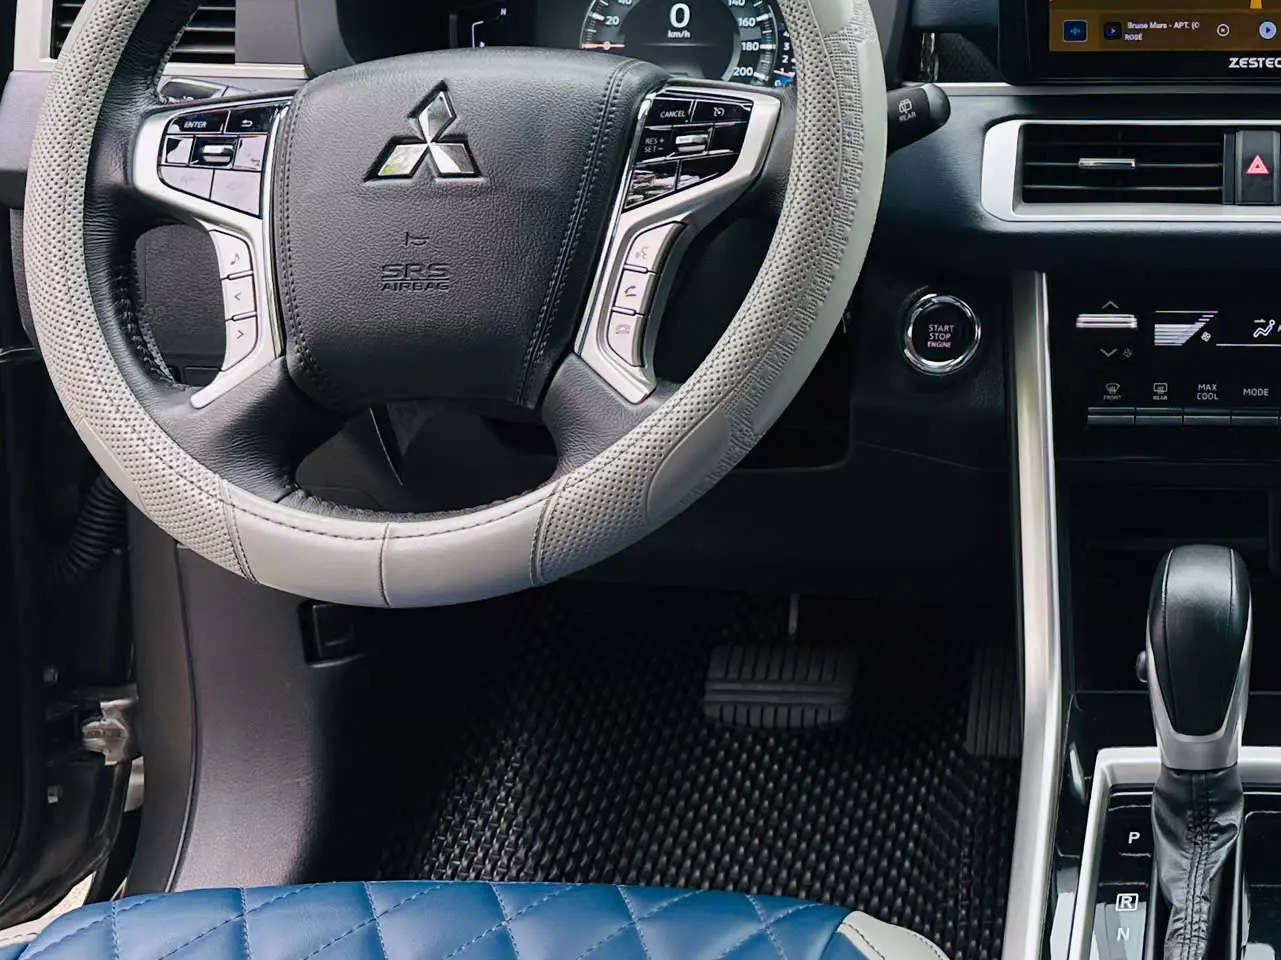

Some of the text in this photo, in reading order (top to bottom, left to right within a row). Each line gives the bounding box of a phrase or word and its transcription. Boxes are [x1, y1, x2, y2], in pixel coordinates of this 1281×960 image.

[605, 15, 620, 25] 20
[669, 3, 691, 28] 0
[738, 17, 756, 27] 160
[667, 30, 691, 39] km/h
[741, 41, 759, 51] 180
[733, 67, 754, 77] 200
[660, 110, 686, 119] CANCEL
[183, 120, 207, 129] ENTER
[381, 263, 451, 279] SRS
[381, 281, 450, 292] AIRBAG
[928, 324, 955, 332] START
[929, 332, 951, 340] STOP
[1197, 383, 1218, 391] MAX
[1196, 392, 1219, 400] COOL
[1242, 388, 1270, 397] MODE
[1128, 831, 1140, 844] P
[1120, 896, 1134, 909] R
[1117, 927, 1131, 941] N
